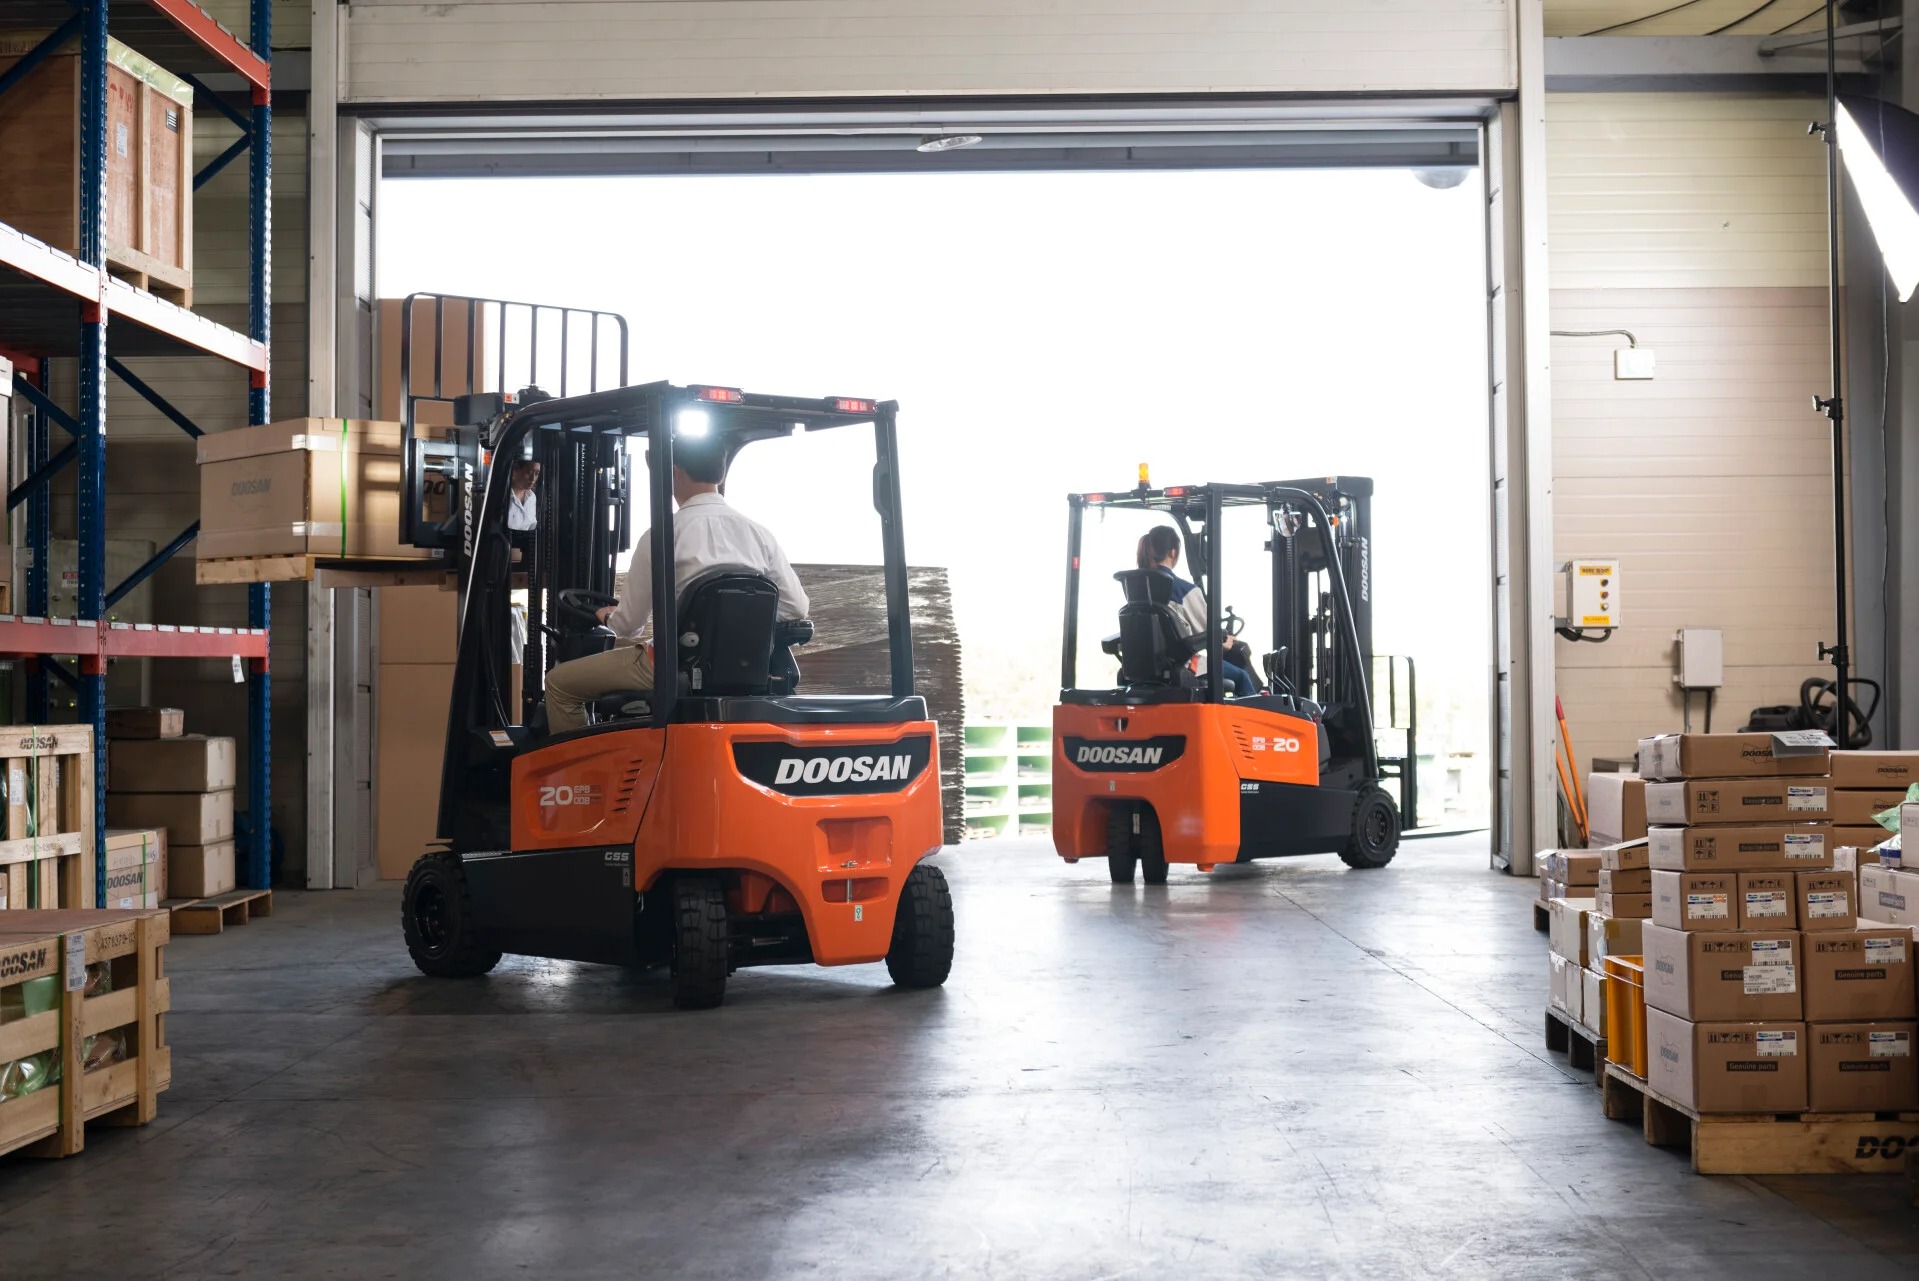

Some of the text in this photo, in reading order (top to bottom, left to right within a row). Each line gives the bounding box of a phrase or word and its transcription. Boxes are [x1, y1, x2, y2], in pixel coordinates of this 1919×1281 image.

[464, 463, 473, 557] DOOSAN
[1273, 737, 1300, 753] 20
[1077, 747, 1163, 764] DOOSAN
[774, 755, 912, 785] DOOSAN
[540, 785, 573, 806] 20
[573, 785, 591, 794] EPB
[605, 851, 630, 862] GSS
[107, 872, 144, 890] DOOSAN
